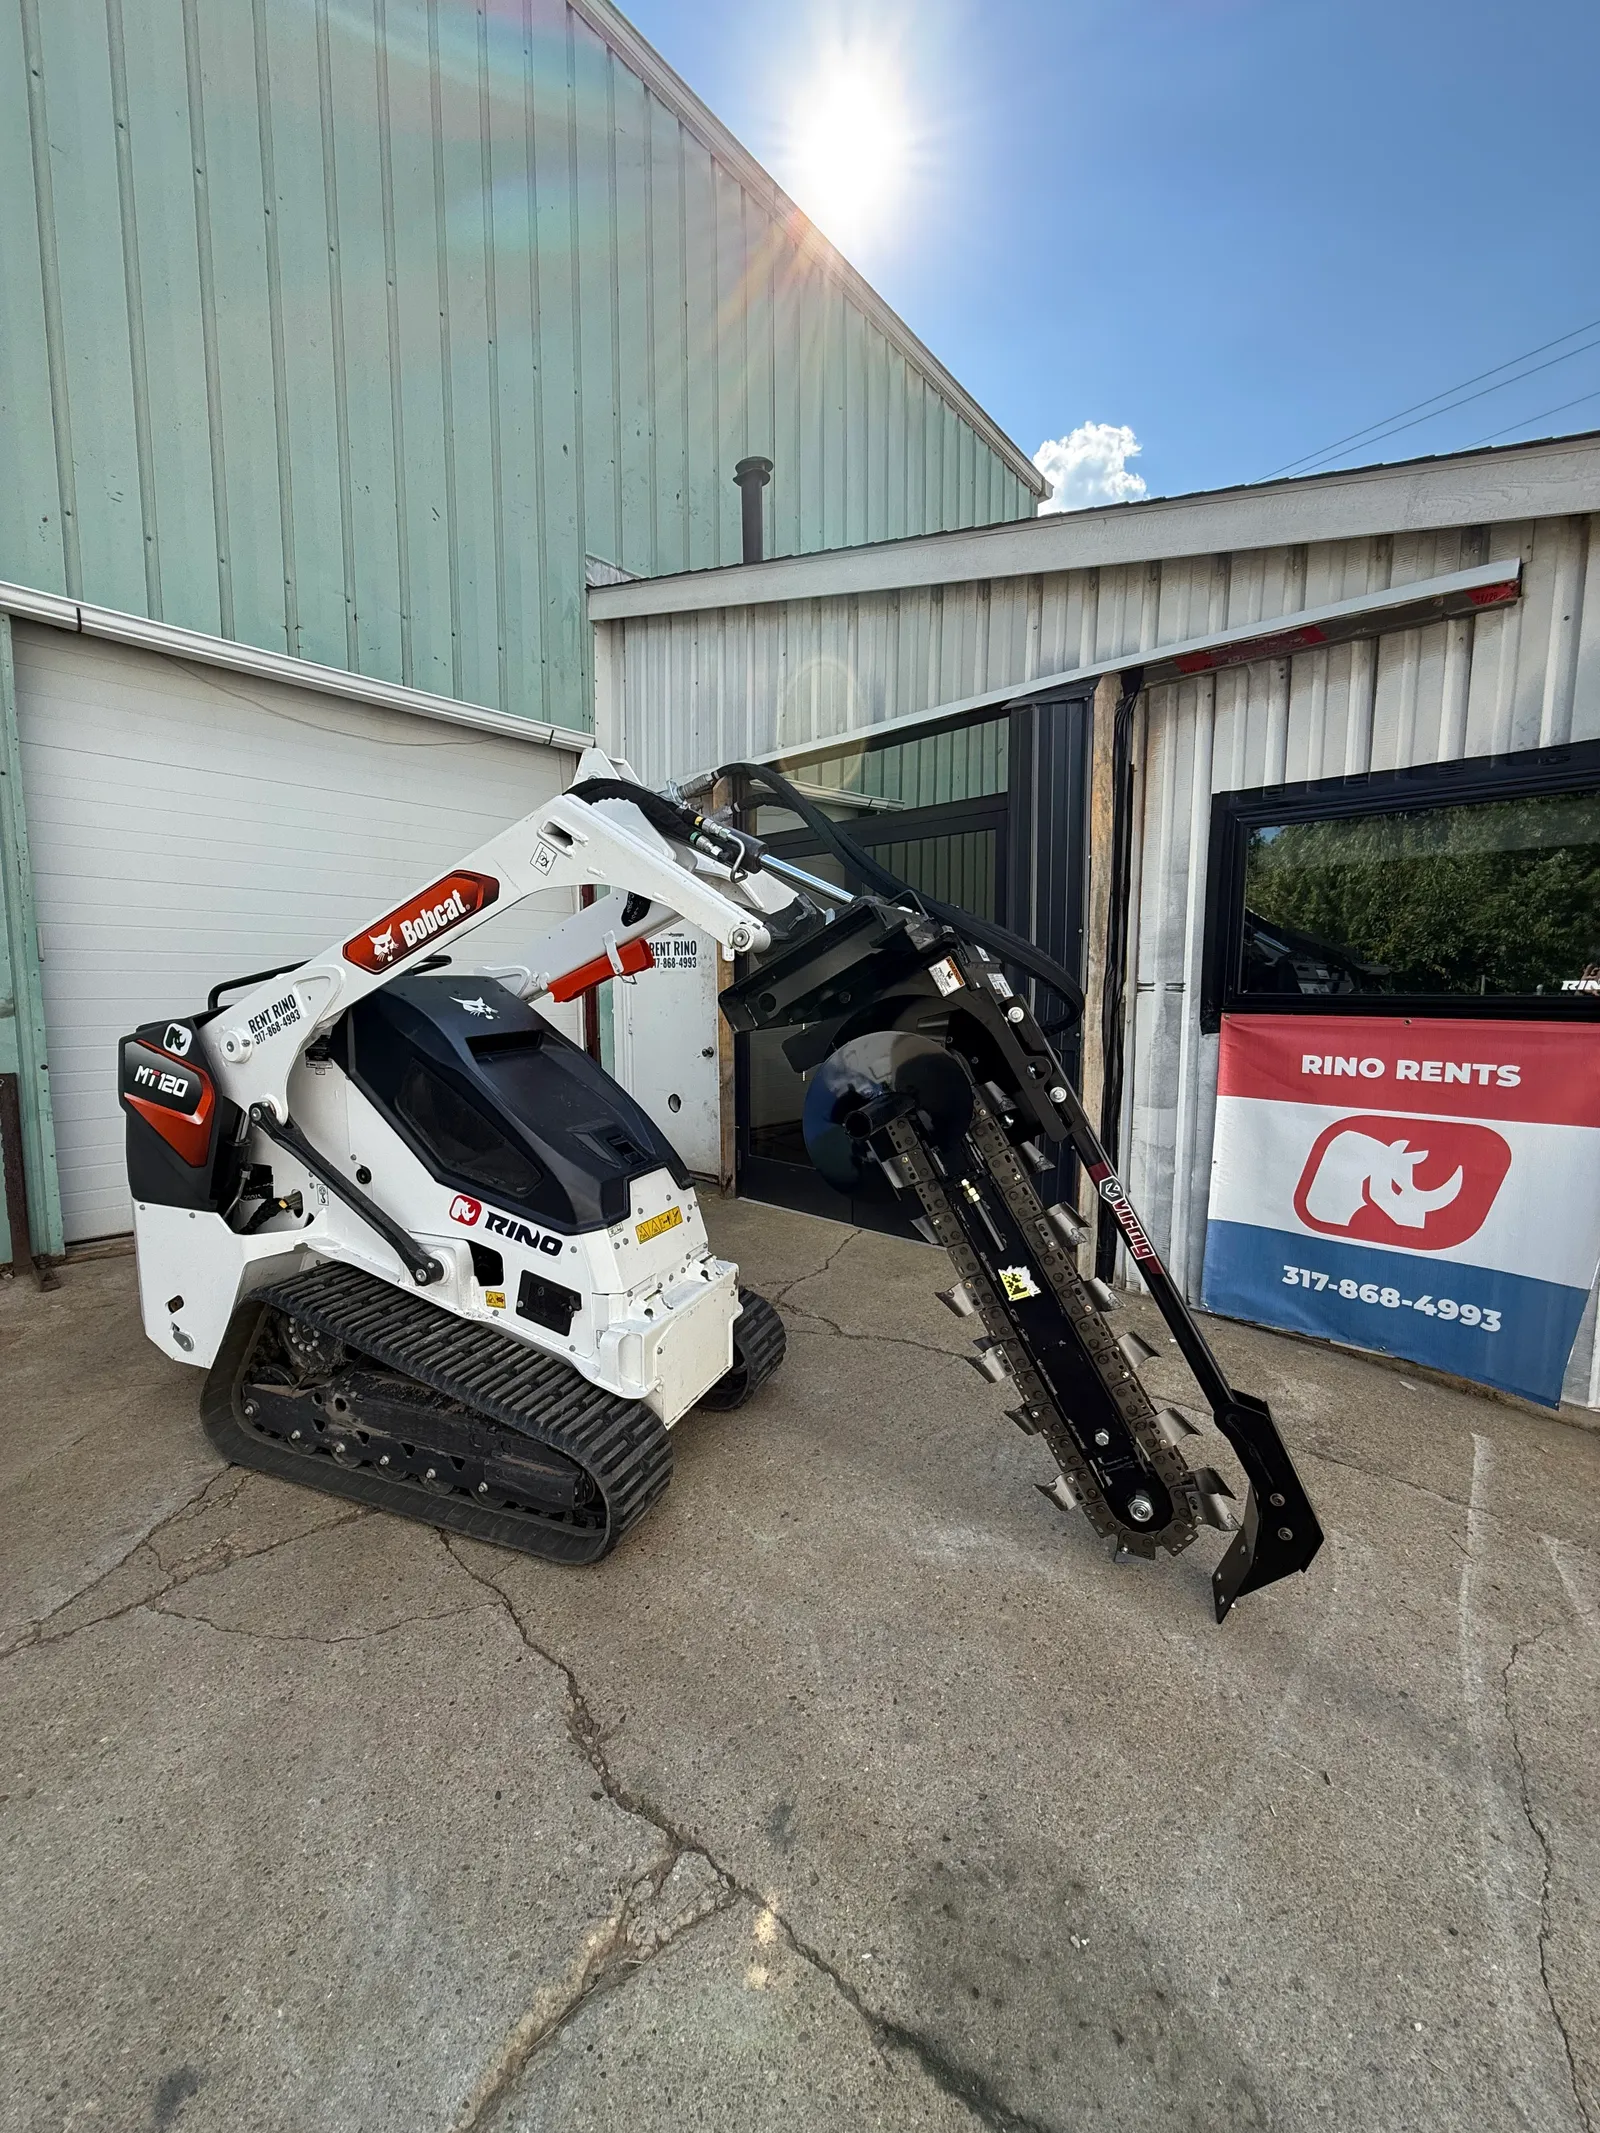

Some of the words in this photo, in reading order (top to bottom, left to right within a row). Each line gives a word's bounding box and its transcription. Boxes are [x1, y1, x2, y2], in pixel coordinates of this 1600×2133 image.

[399, 889, 466, 947] Bobcat
[649, 941, 671, 956] RENT
[674, 940, 697, 956] RINO
[653, 957, 697, 968] 17-868-4993
[248, 1008, 271, 1034] RENT
[271, 994, 296, 1019] RINO
[254, 1009, 301, 1045] 317-868-4993
[1301, 1055, 1385, 1078] RINO
[1396, 1059, 1521, 1087] RENTS
[485, 1211, 563, 1256] RINO
[1281, 1265, 1502, 1332] 317-868-4993
